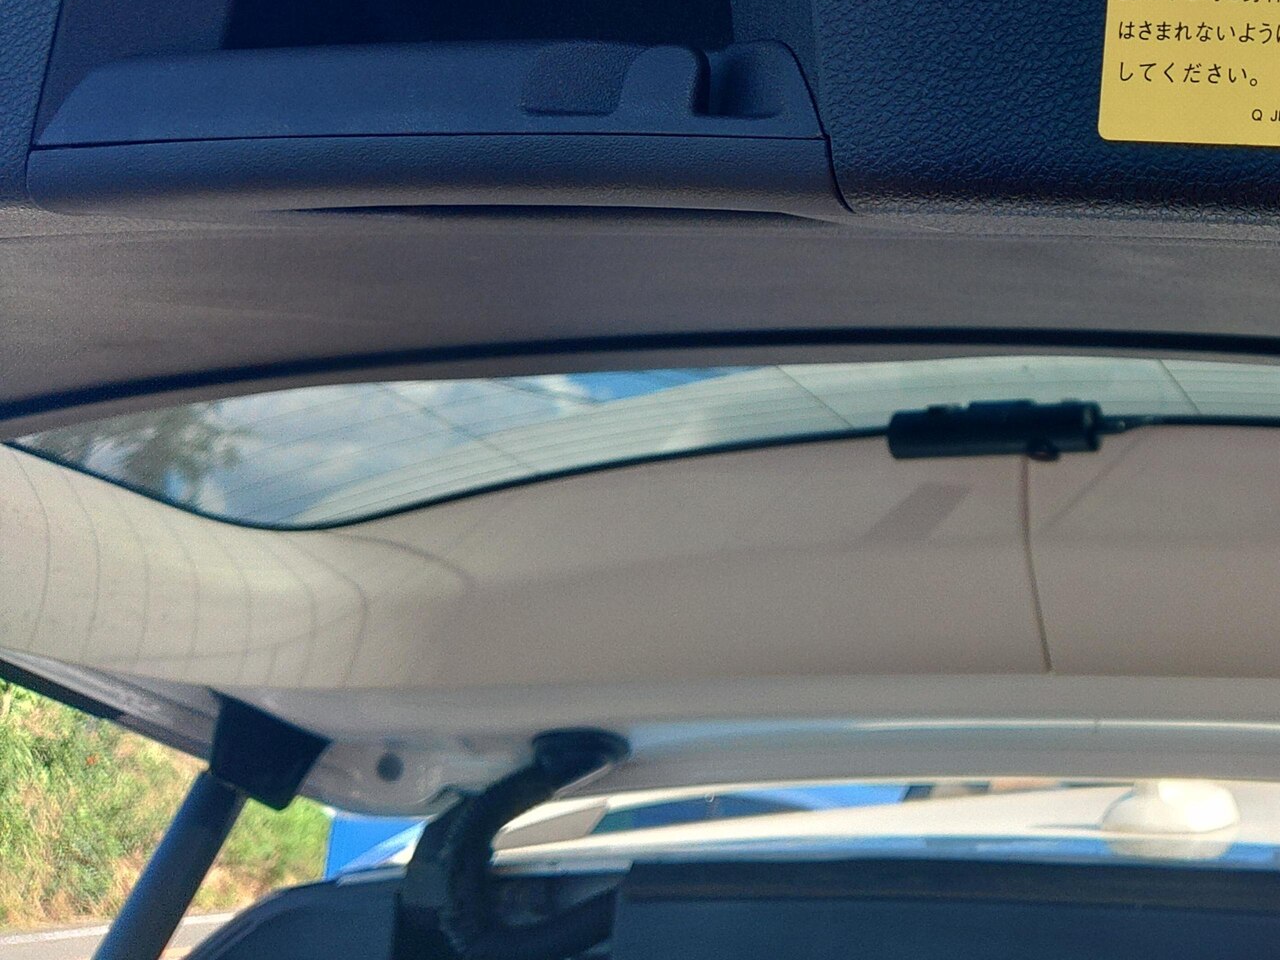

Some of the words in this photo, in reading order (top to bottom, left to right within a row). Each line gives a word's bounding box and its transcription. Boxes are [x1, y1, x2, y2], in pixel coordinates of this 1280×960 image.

[1118, 61, 1259, 87] してください。
[1251, 108, 1263, 122] Q
